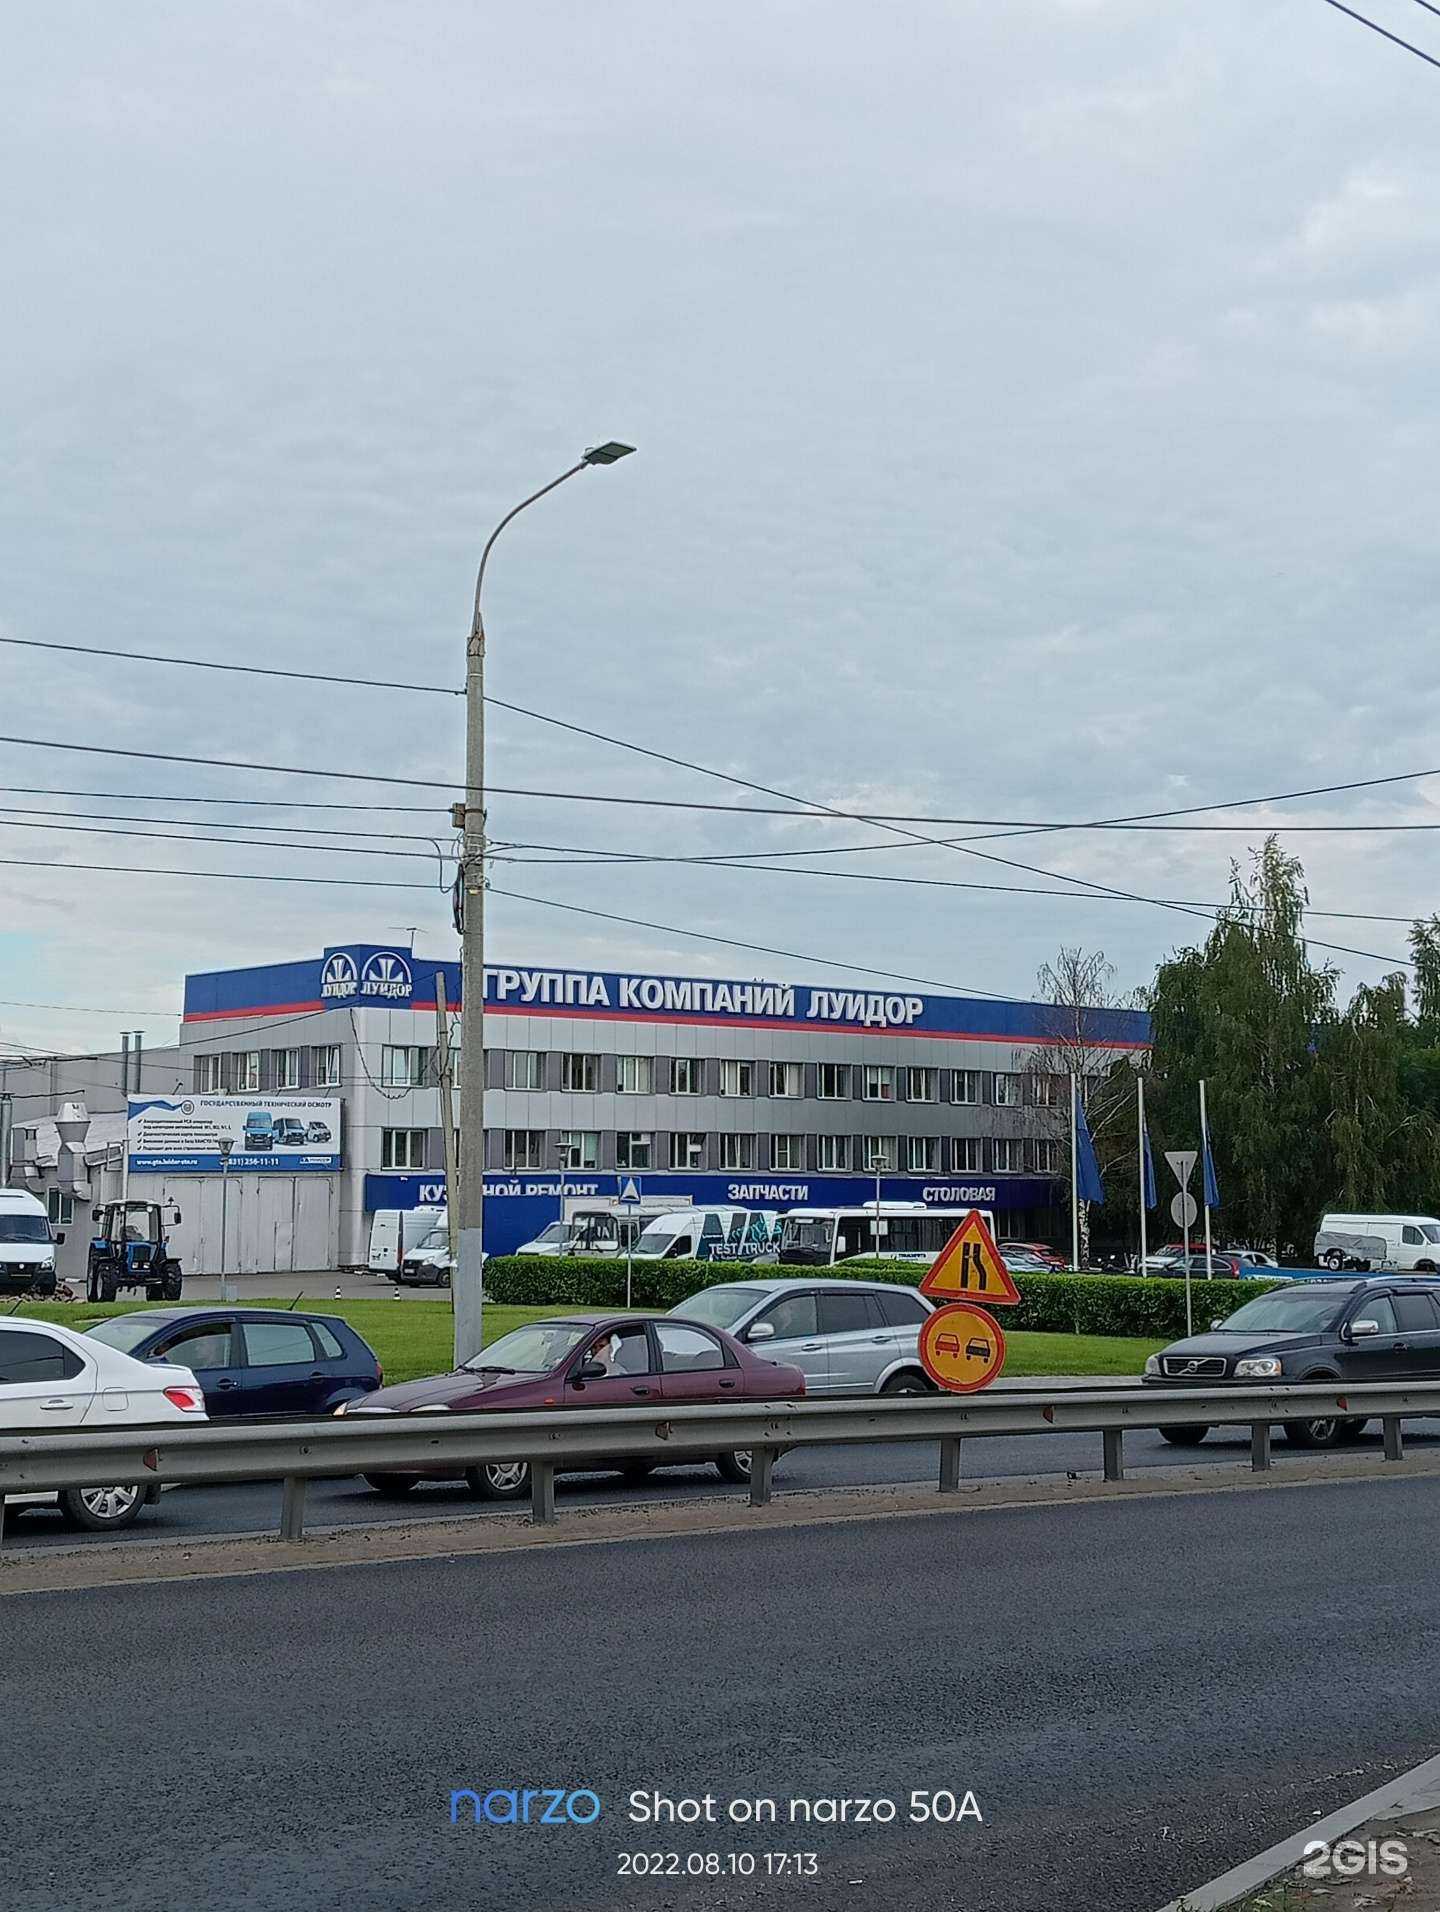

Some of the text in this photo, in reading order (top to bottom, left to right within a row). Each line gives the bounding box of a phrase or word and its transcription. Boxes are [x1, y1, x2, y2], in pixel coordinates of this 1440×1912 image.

[360, 981, 412, 999] ЛУИДОР
[483, 968, 923, 1027] ГРУППА КОМПАНИЙ ЛУИДОР
[419, 1179, 522, 1202] КУНОЙ
[727, 1184, 809, 1201] ЗАПЧАСТИ
[922, 1187, 996, 1201] СТОЛОВАЯ
[708, 1242, 781, 1255] TEST TRUCK
